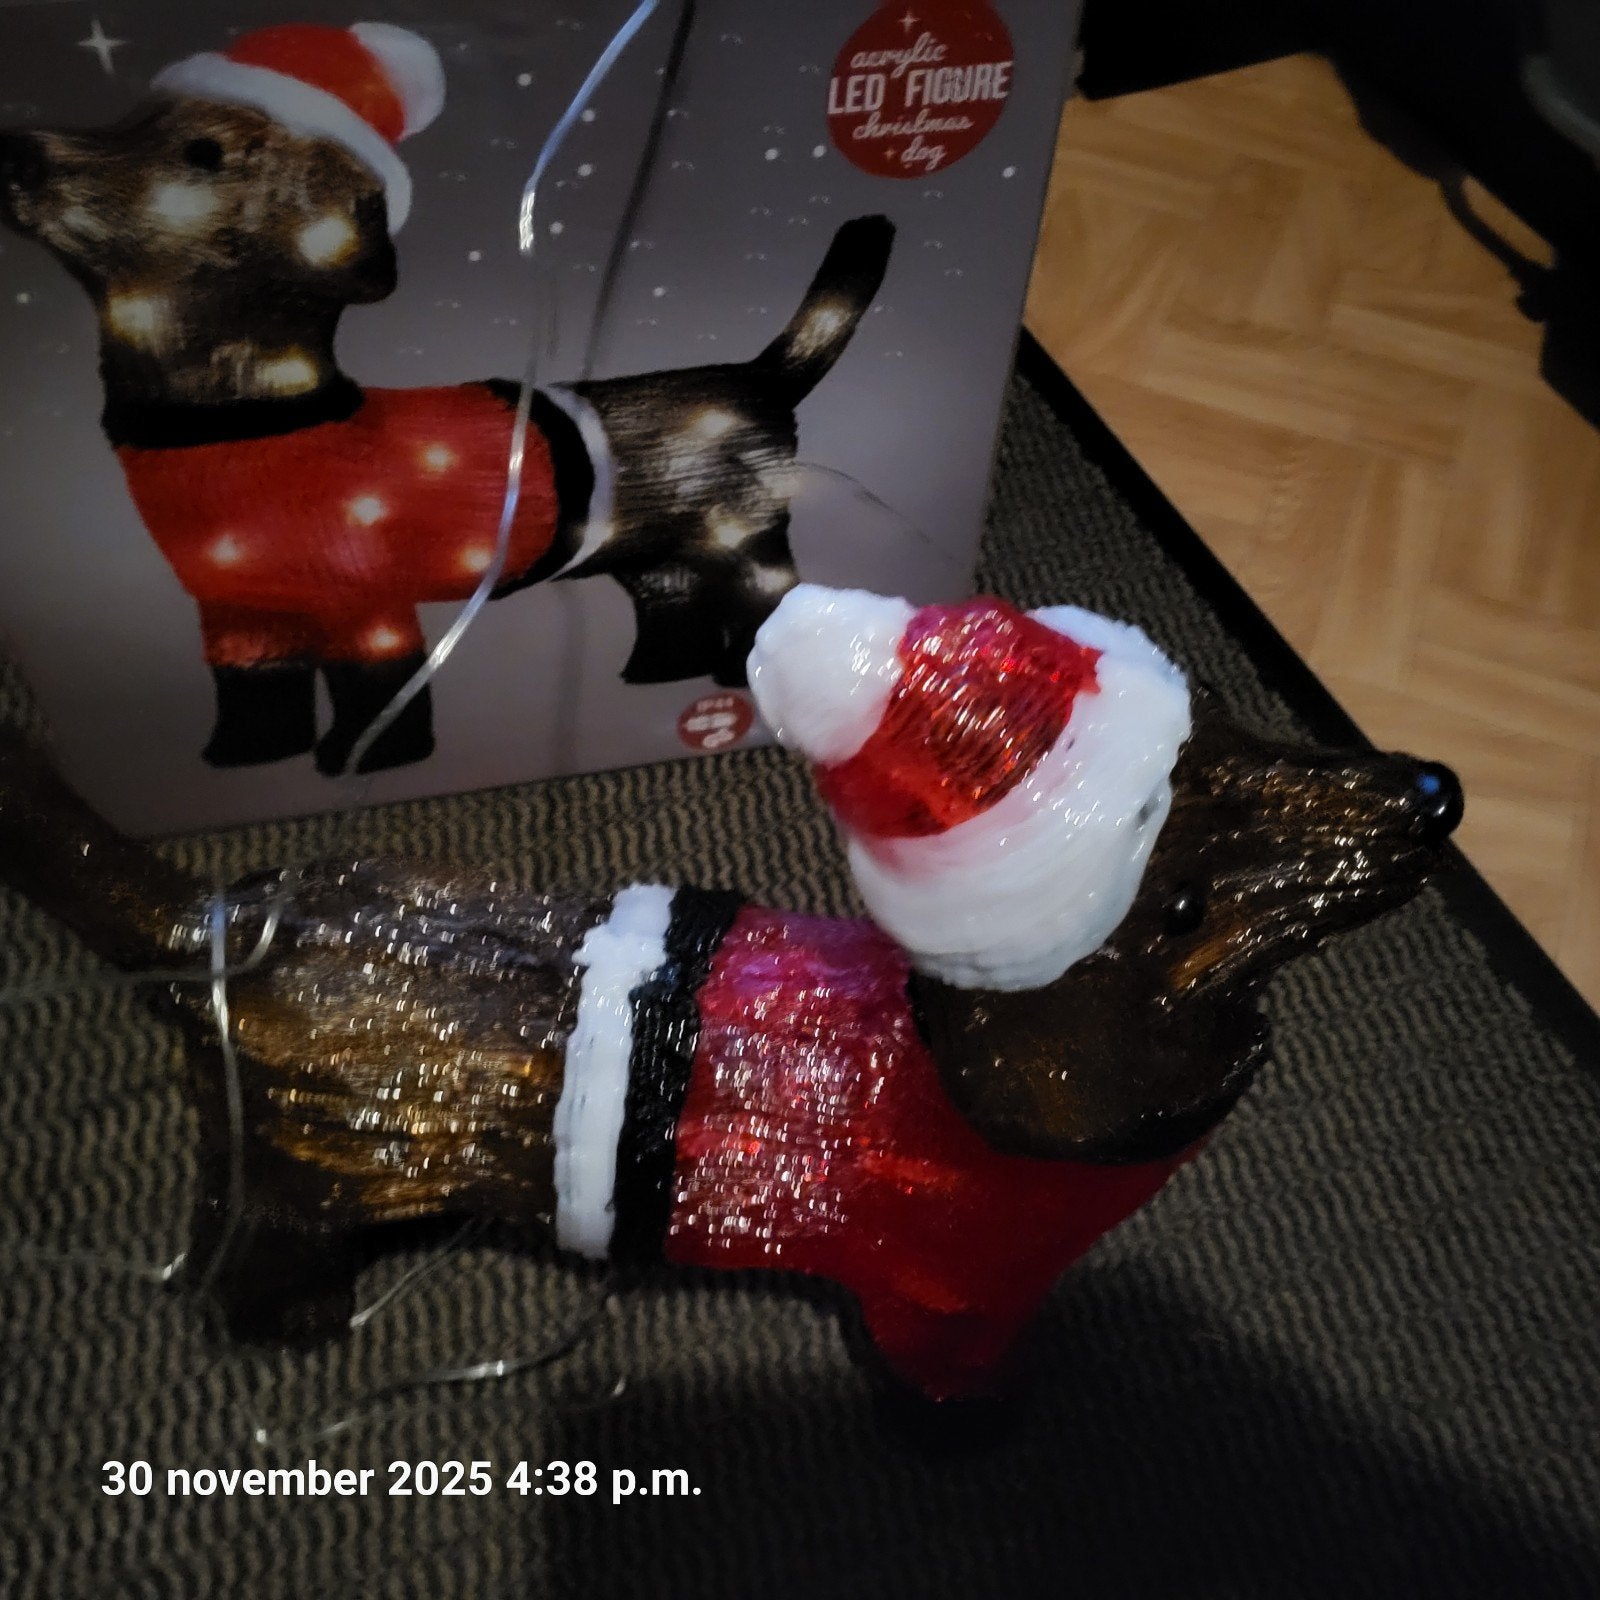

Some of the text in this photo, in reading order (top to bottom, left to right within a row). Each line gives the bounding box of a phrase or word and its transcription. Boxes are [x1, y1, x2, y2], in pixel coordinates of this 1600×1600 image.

[850, 31, 948, 79] acrylic
[827, 61, 1013, 115] LED FIGURE
[852, 108, 974, 140] christmas
[901, 135, 947, 171] dog
